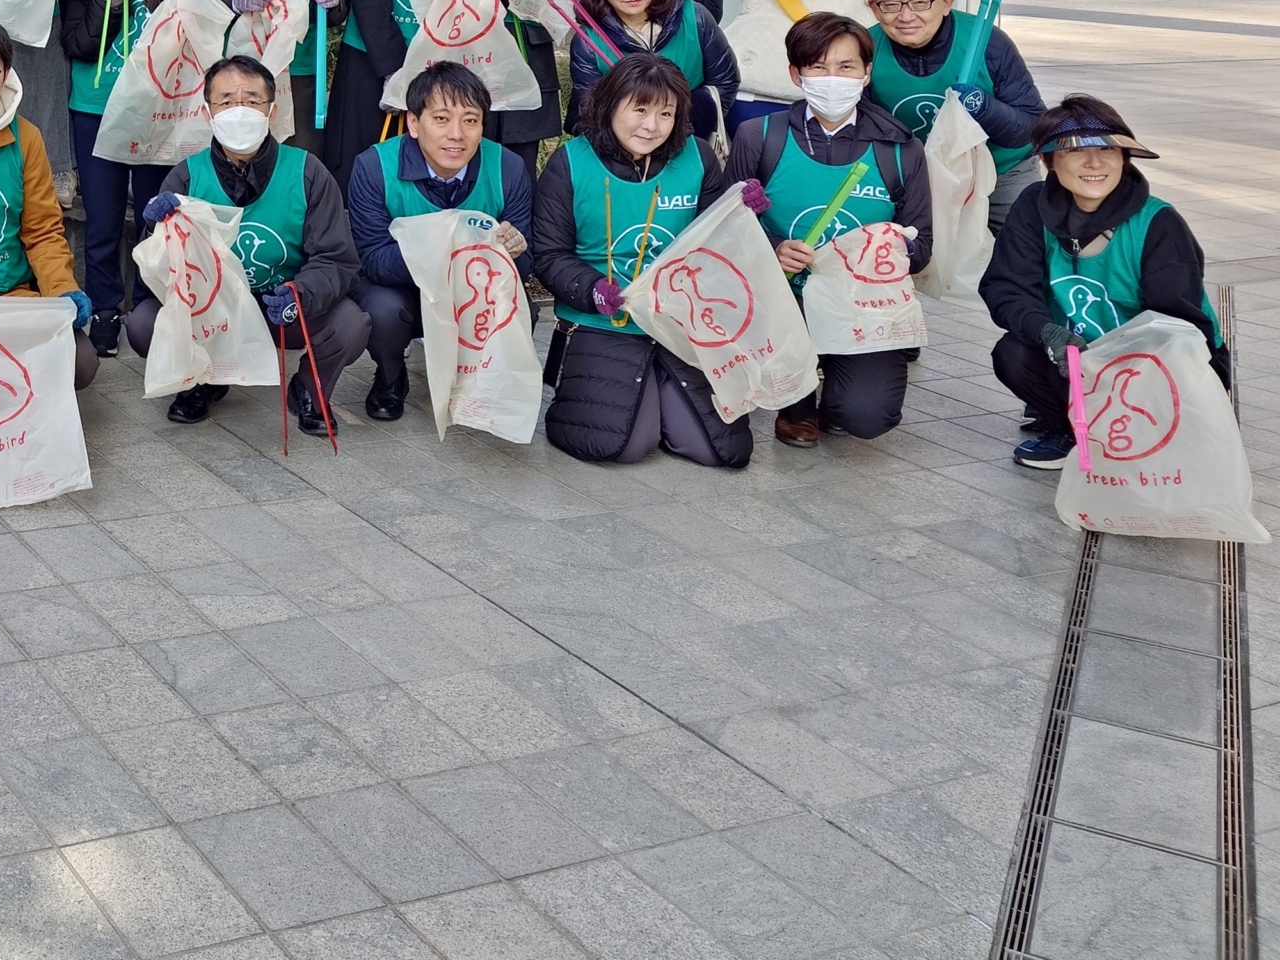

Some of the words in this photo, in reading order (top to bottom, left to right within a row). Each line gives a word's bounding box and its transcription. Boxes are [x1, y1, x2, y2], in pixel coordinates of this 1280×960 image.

[392, 14, 420, 25] reen
[463, 52, 492, 67] bird
[104, 62, 123, 74] gre
[851, 183, 891, 200] UAC
[713, 352, 749, 379] green
[749, 338, 774, 361] ird
[1140, 469, 1182, 487] bird
